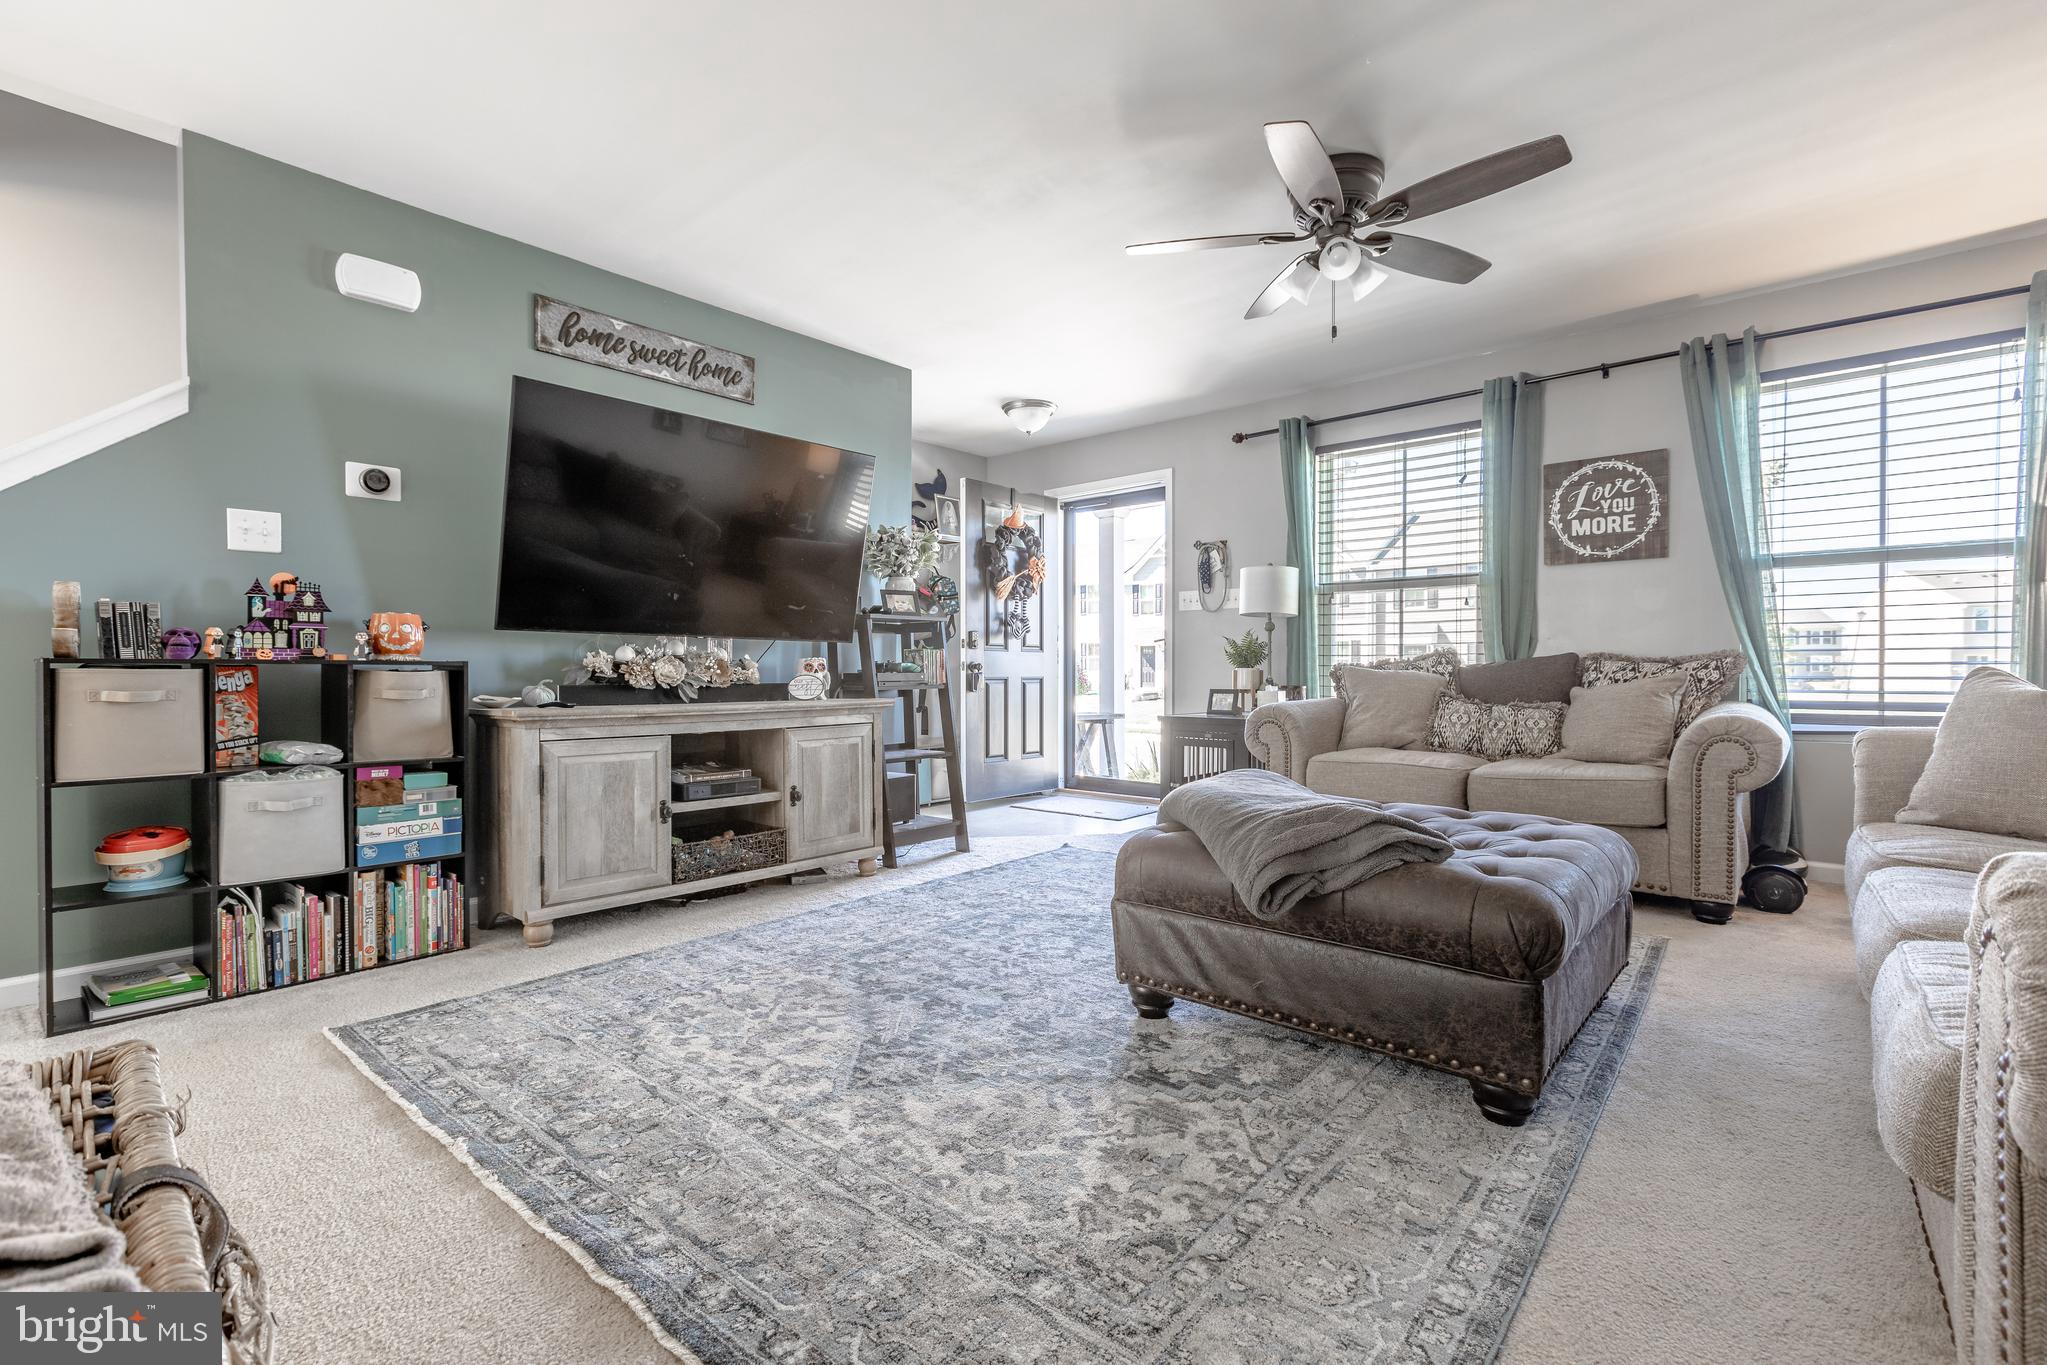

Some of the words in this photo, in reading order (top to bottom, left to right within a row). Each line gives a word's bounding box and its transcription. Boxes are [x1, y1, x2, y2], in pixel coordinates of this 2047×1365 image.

[558, 311, 627, 355] home
[627, 340, 690, 371] sweet
[688, 348, 743, 387] home
[1567, 478, 1641, 520] Love
[1600, 496, 1635, 514] YOU
[1571, 513, 1637, 537] MORE
[387, 821, 440, 837] PICTOPIA
[365, 907, 374, 925] BIG
